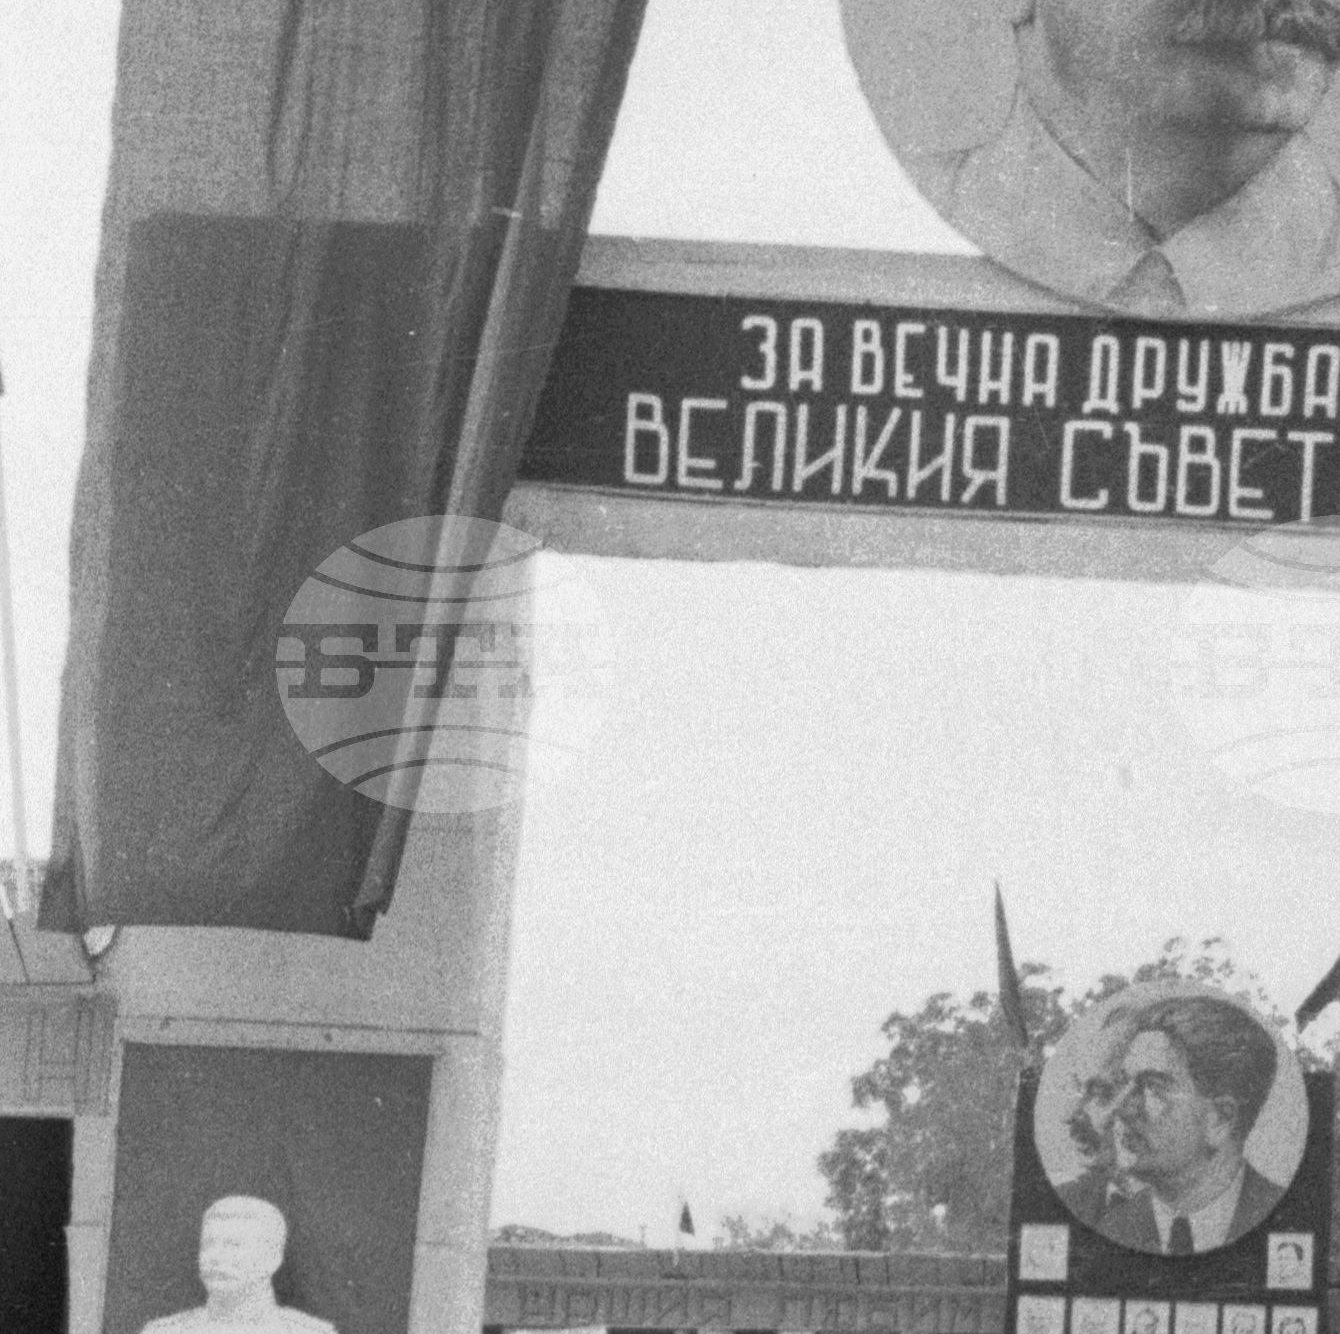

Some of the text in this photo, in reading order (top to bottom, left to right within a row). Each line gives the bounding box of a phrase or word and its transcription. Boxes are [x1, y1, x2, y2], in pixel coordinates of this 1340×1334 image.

[740, 314, 825, 392] ЗА
[850, 318, 1060, 408] ВЕЧНА
[624, 393, 1011, 505] ВЕЛИКИЯ
